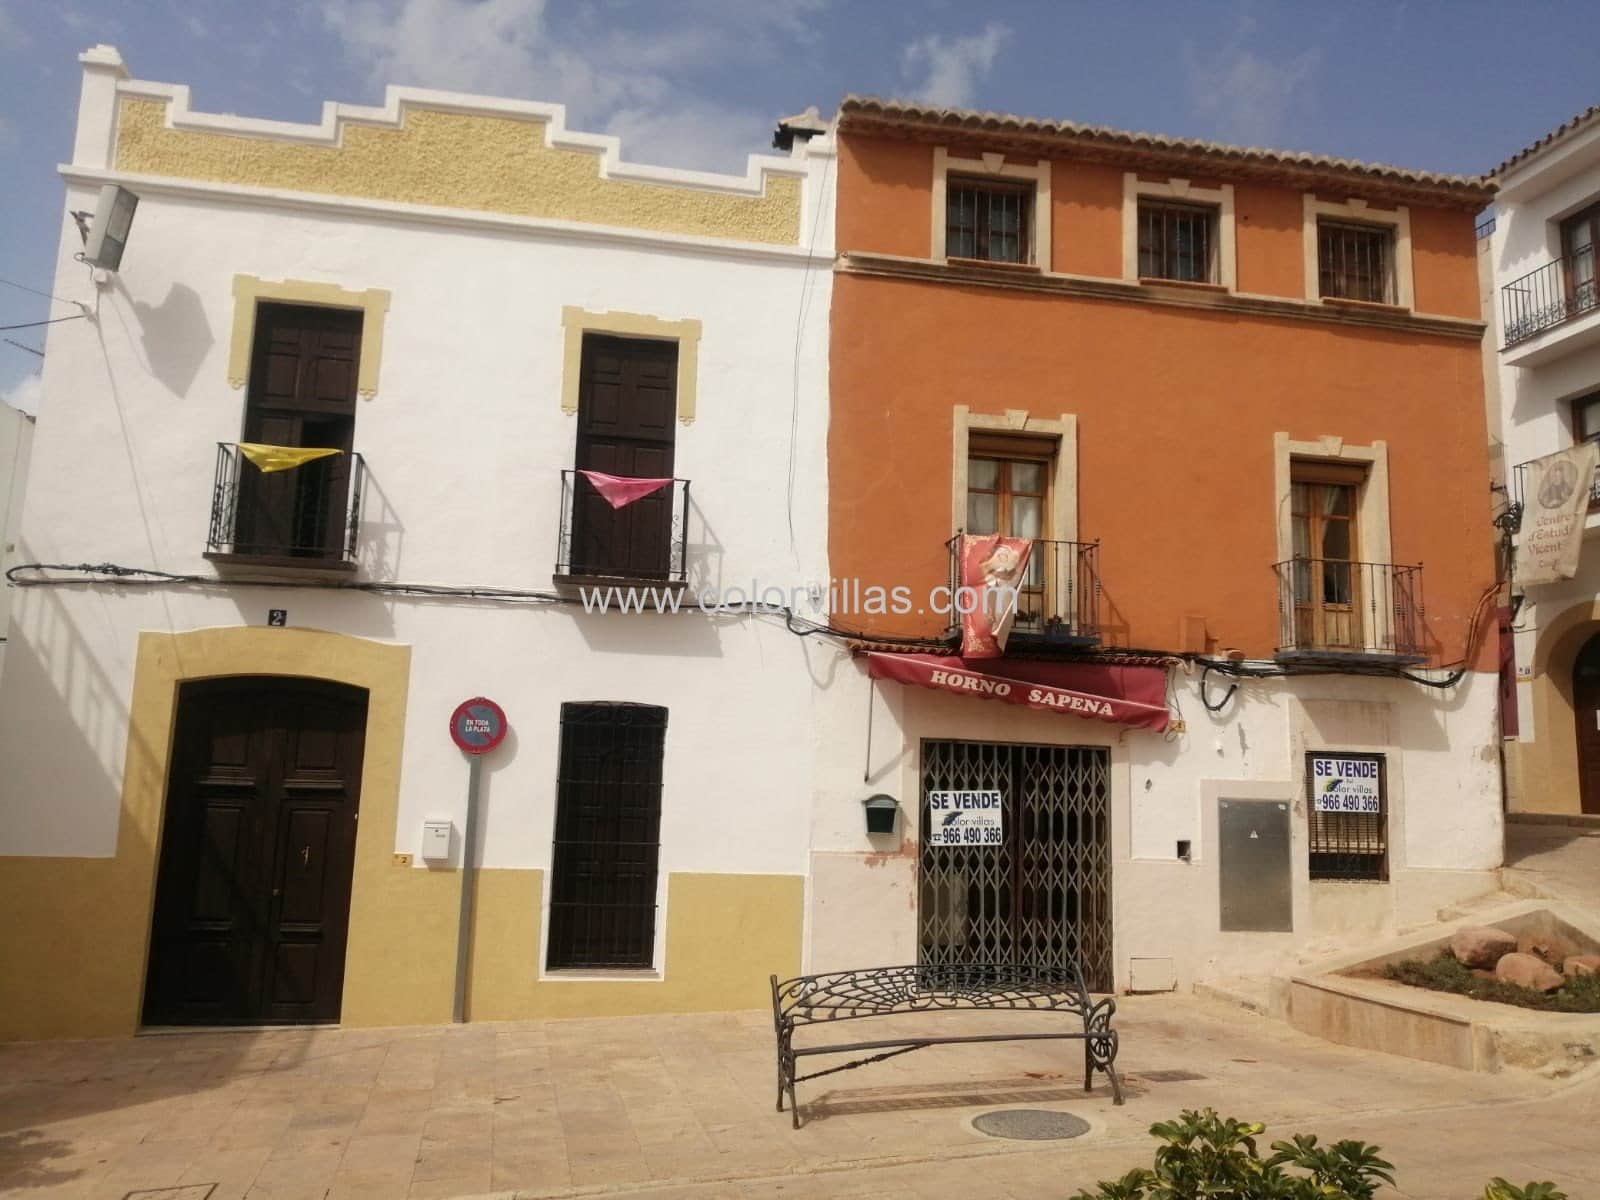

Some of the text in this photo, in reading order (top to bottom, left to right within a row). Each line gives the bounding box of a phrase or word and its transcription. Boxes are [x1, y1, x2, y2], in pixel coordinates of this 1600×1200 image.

[272, 611, 281, 626] 2
[930, 670, 1114, 716] HORNO SAPENA
[1315, 760, 1377, 778] SE VENDE
[932, 792, 1000, 809] SE VENDE
[1322, 794, 1378, 811] 966 490 366
[943, 827, 1001, 844] 966 490 366
